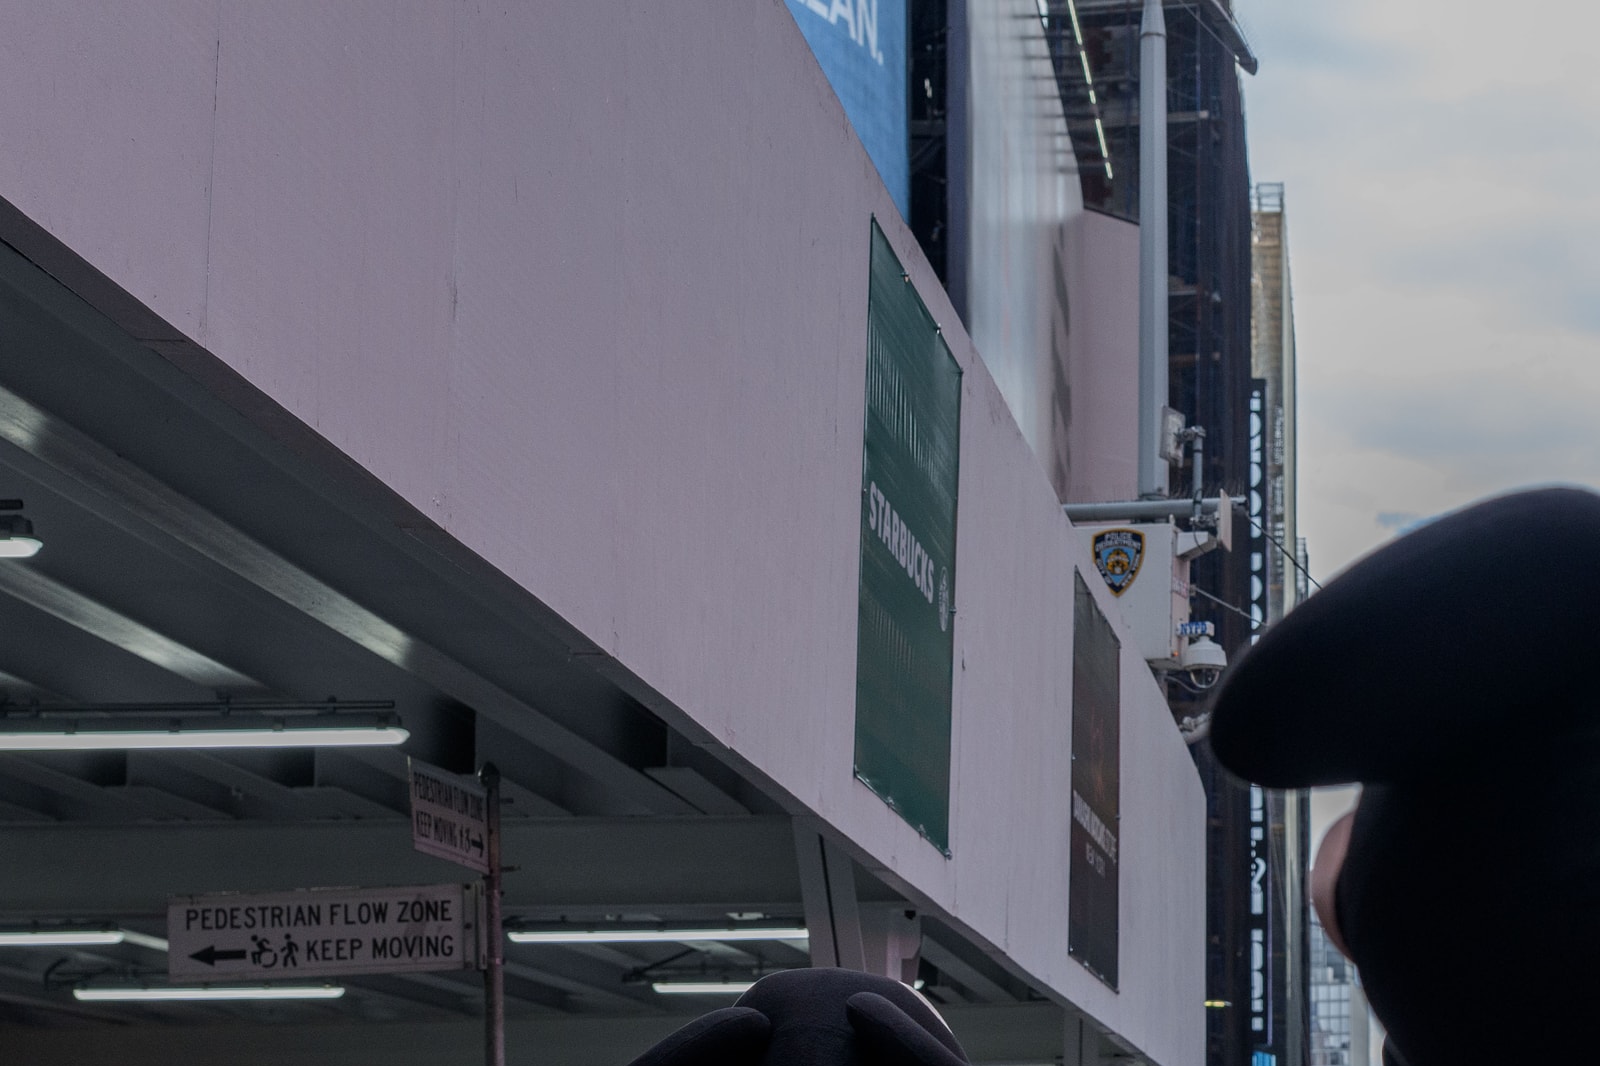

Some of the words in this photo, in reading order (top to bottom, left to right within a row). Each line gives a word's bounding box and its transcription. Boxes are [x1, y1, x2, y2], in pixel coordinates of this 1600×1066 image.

[869, 480, 935, 604] STARBUCKS
[1181, 622, 1208, 635] NYPD
[413, 772, 453, 811] PEDESTRIAN
[453, 785, 469, 815] FLOW
[415, 811, 431, 839] KEEP
[433, 817, 457, 848] MOVING
[186, 905, 321, 931] PEDESTRIAN
[330, 902, 388, 926] FLOW
[397, 900, 452, 923] ZONE
[306, 938, 363, 961] KEEP
[372, 935, 453, 959] MOVING
